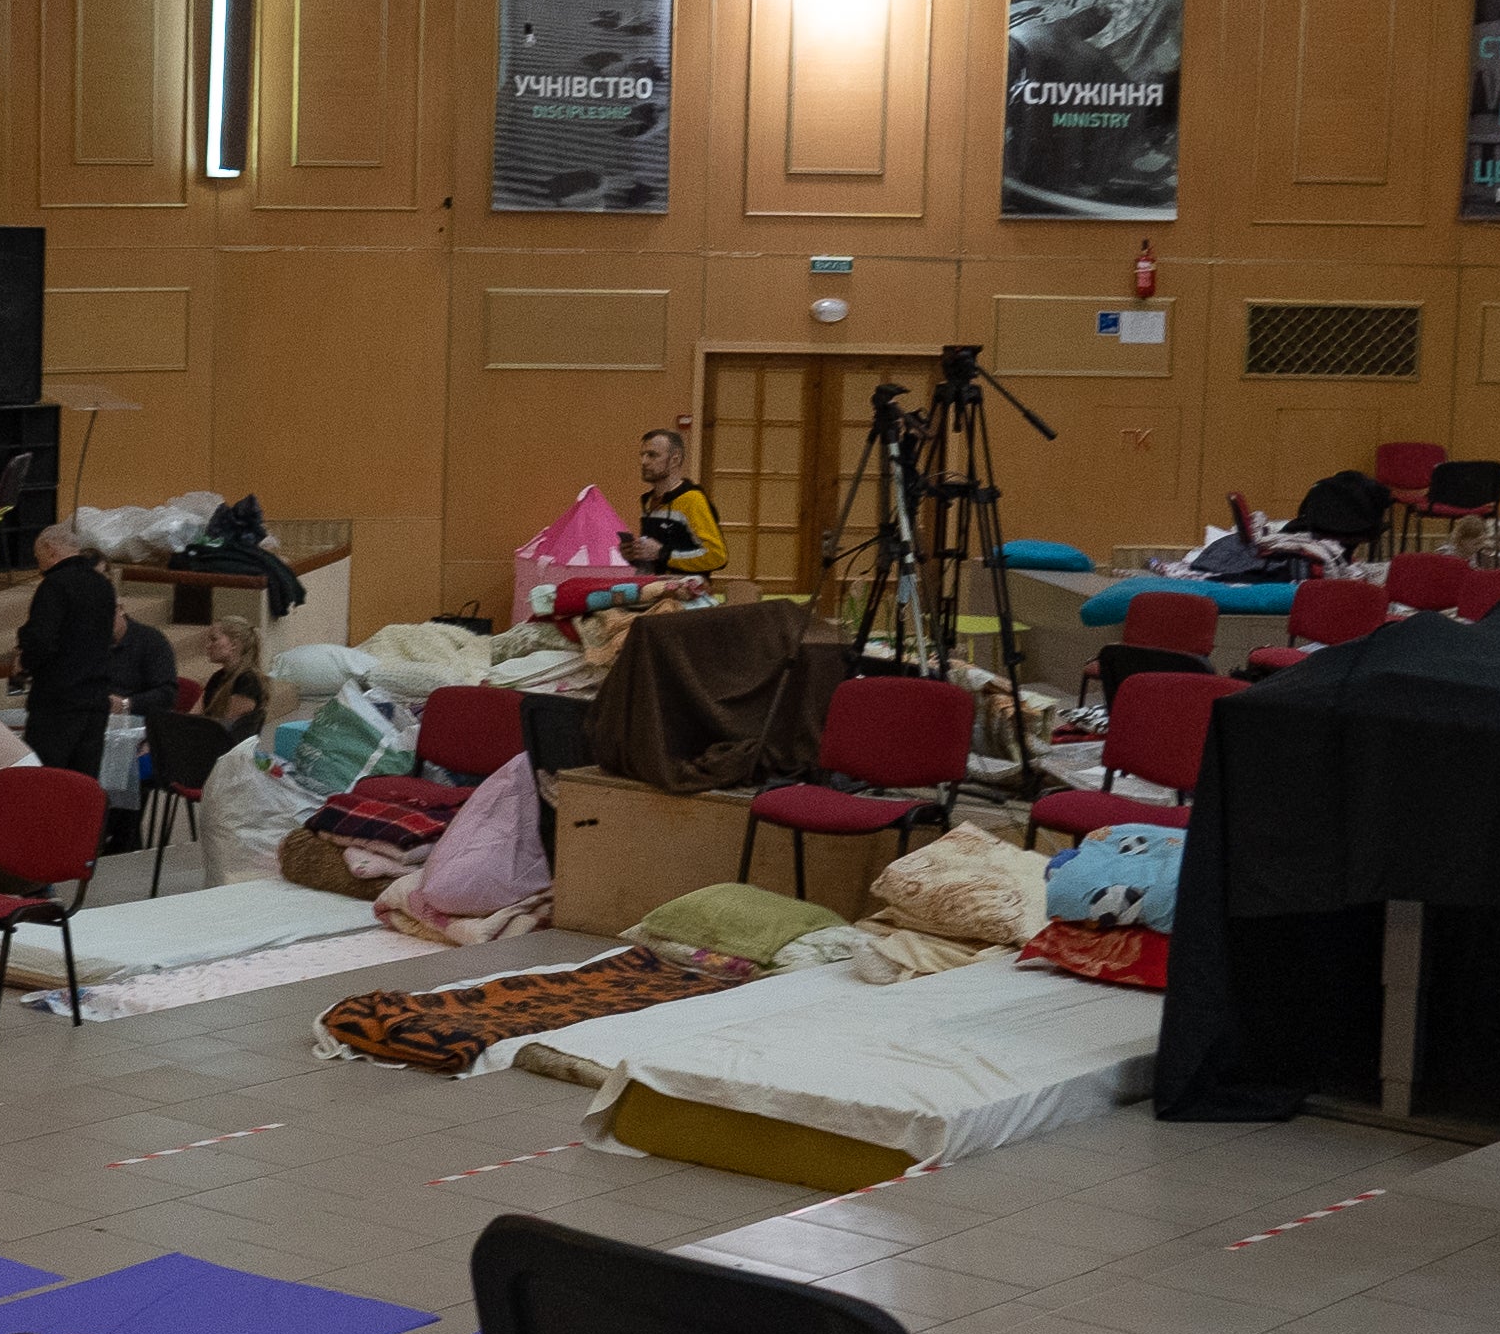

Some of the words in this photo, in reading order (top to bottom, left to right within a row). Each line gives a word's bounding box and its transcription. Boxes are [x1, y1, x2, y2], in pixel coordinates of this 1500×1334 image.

[514, 75, 653, 99] УЧНІВСТВО
[1023, 81, 1164, 106] СЛУЖІННЯ
[1052, 112, 1131, 128] MINISTRY
